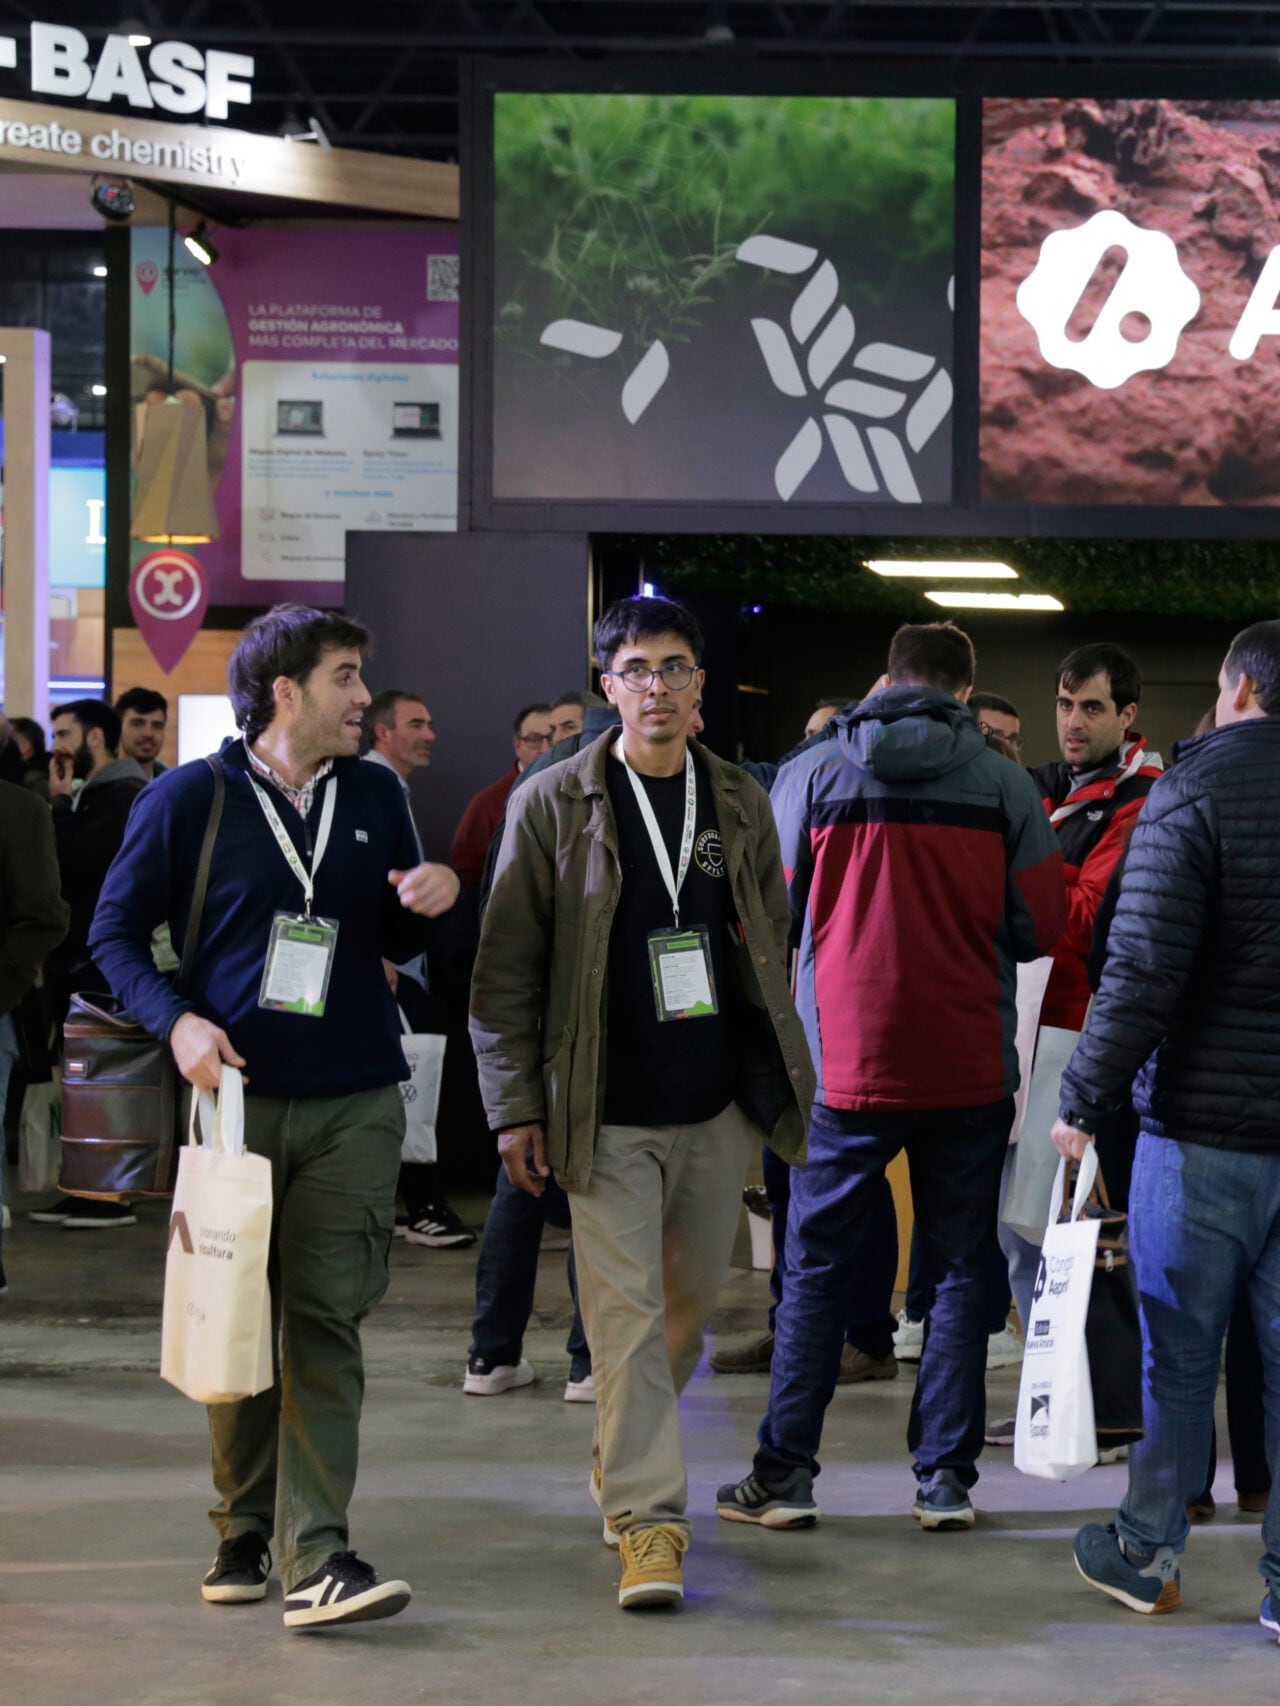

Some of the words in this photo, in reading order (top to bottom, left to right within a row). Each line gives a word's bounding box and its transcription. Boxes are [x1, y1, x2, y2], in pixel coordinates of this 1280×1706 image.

[31, 21, 254, 120] BASF
[90, 128, 246, 185] chemistry
[249, 304, 267, 316] LA
[269, 304, 360, 317] PLATAFORMA
[364, 306, 382, 318] DE
[282, 334, 356, 348] COMPLETA
[359, 336, 386, 349] DEL
[388, 338, 460, 351] MERCADO
